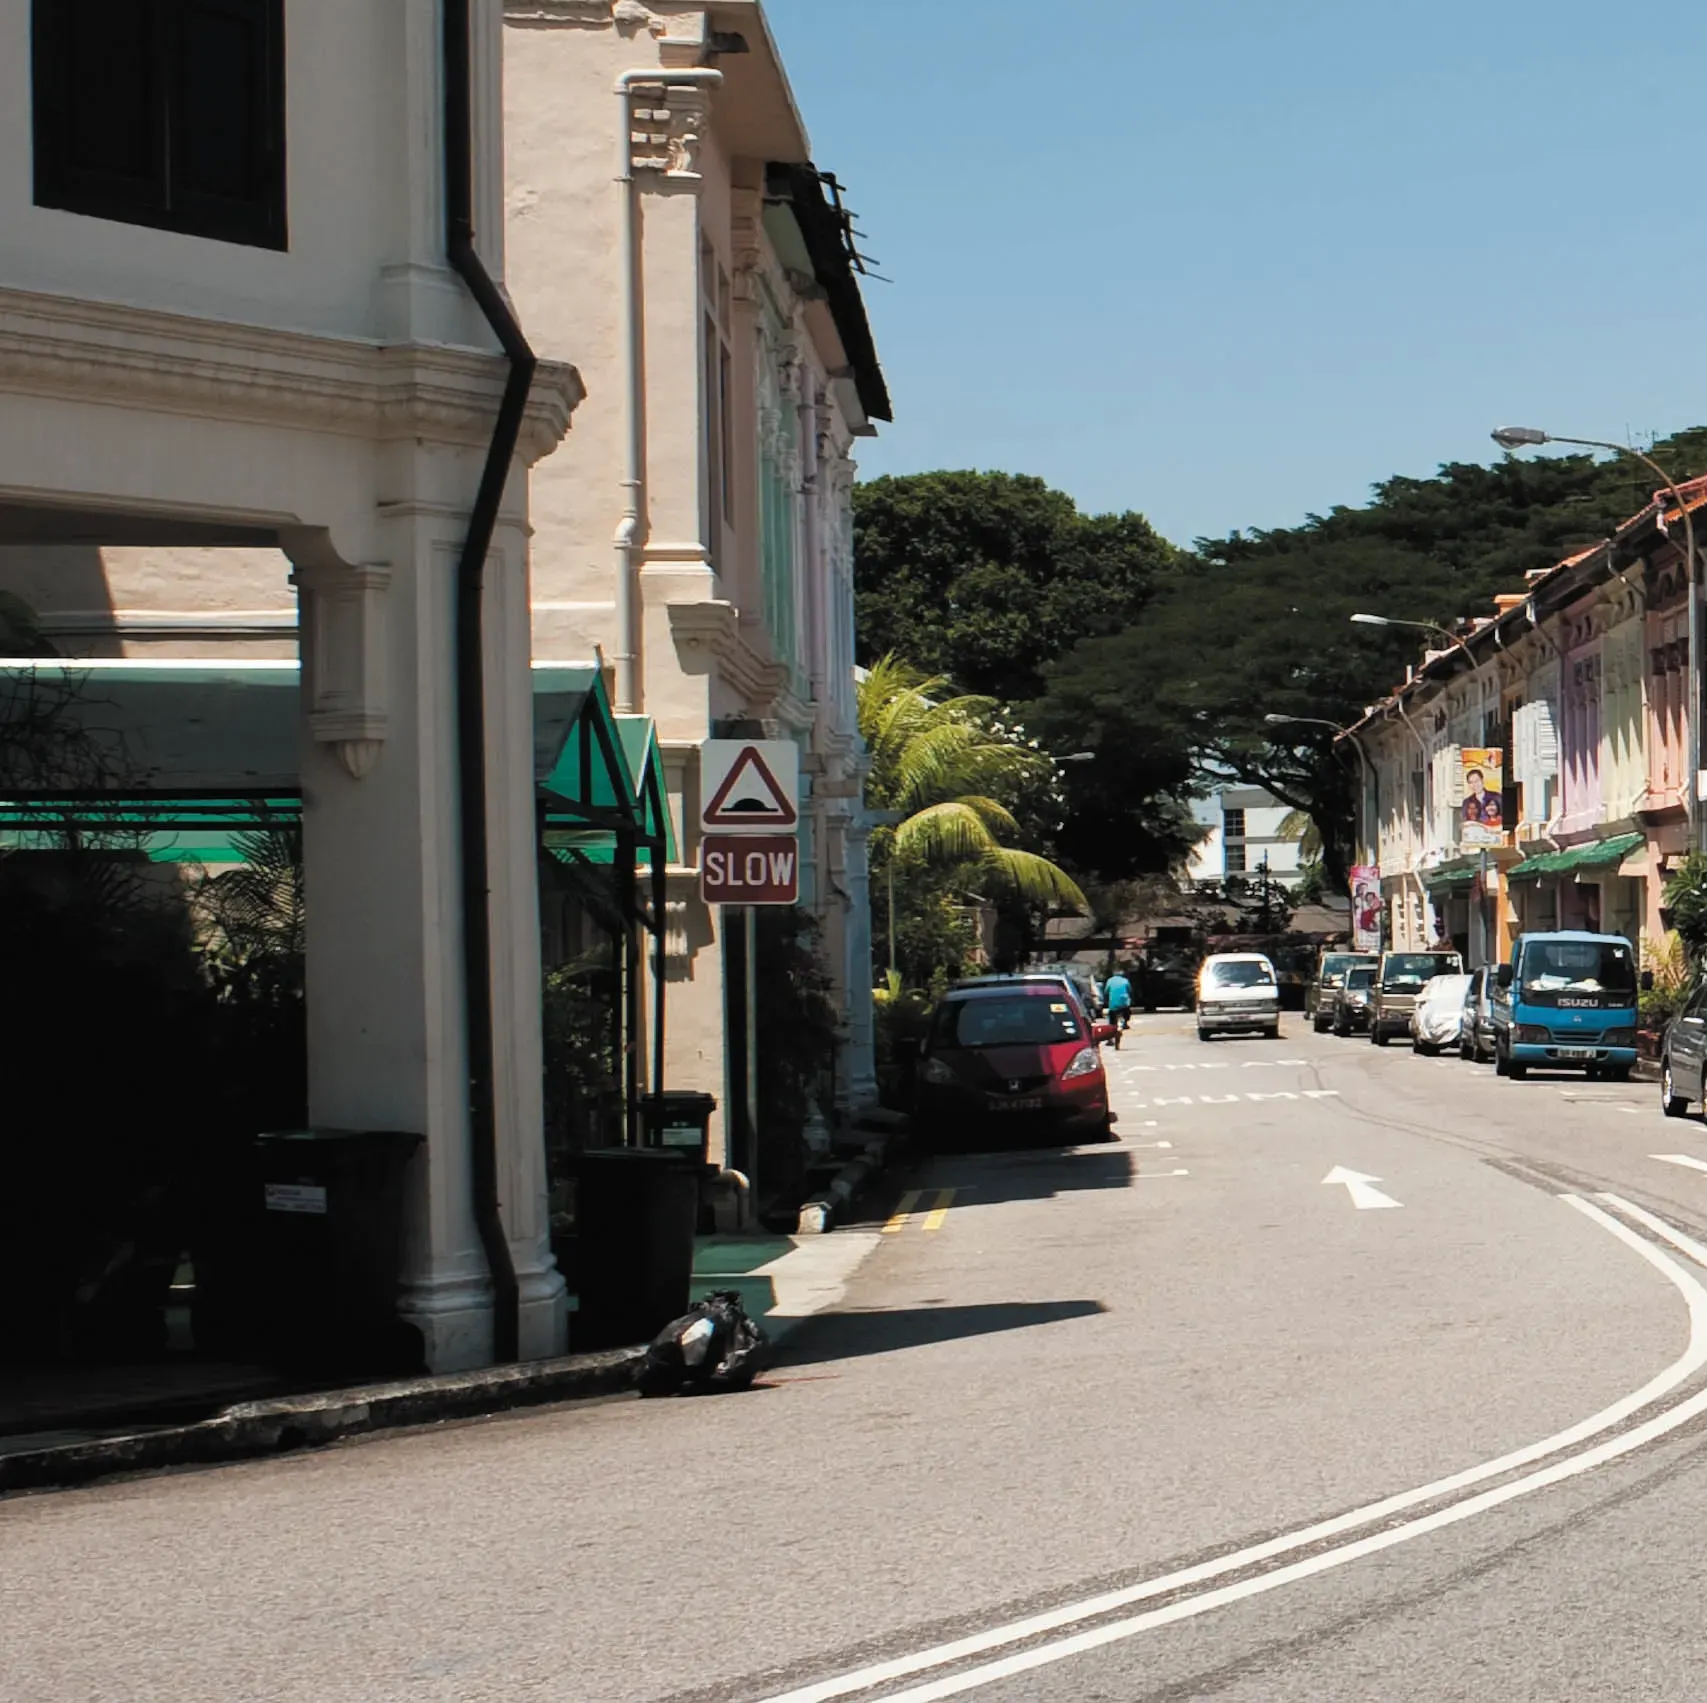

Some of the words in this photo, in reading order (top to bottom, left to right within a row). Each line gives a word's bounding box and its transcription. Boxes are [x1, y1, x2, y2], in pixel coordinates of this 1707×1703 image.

[706, 851, 794, 886] SLOW
[1557, 998, 1599, 1008] ISUZU
[1152, 1090, 1340, 1106] HUMP
